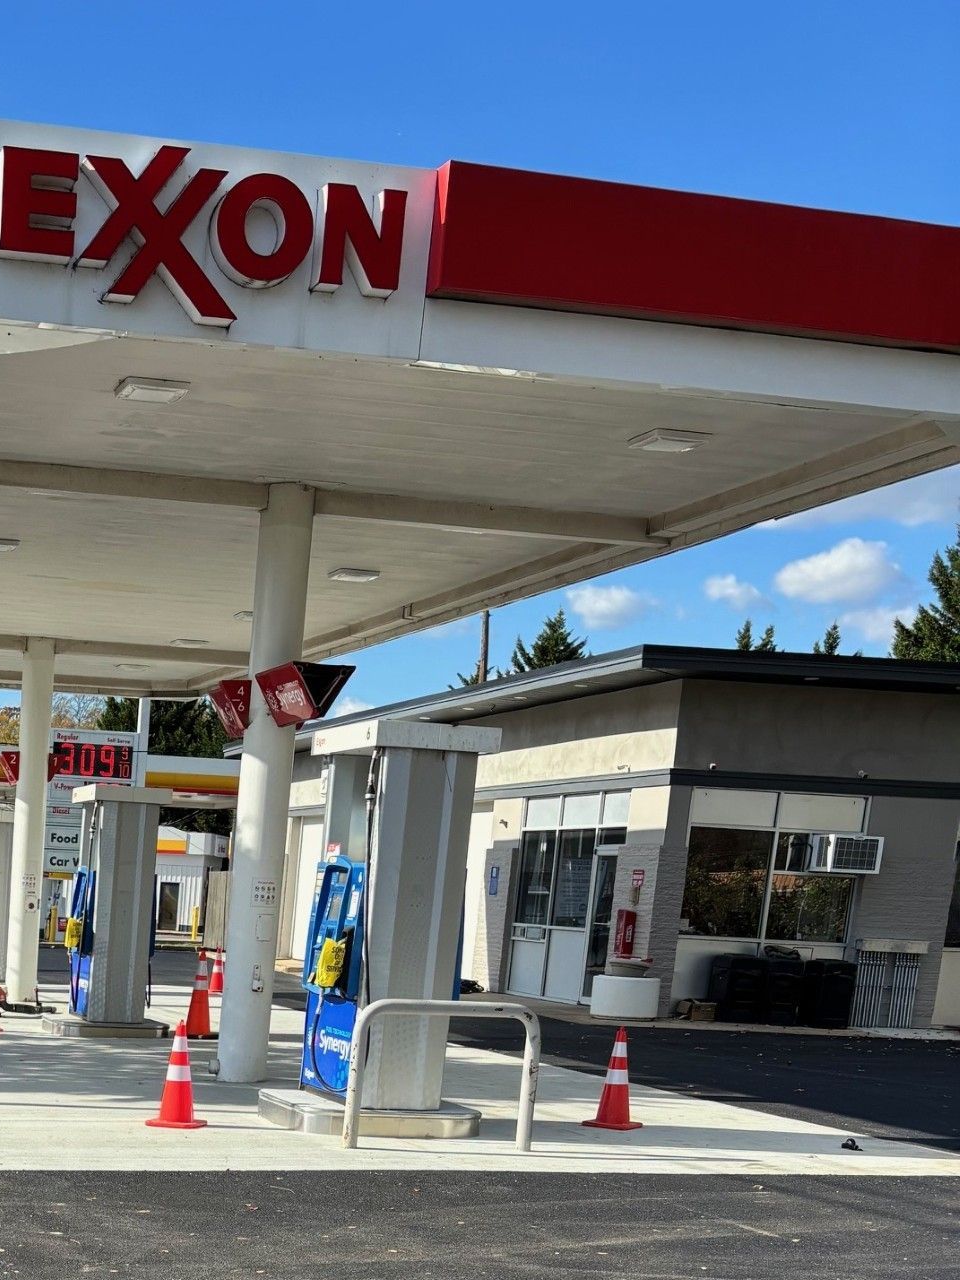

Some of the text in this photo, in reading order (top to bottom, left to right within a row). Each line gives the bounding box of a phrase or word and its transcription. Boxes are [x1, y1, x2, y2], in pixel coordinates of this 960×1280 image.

[237, 686, 245, 696] 4
[238, 701, 245, 712] 6
[56, 732, 79, 742] Regular
[10, 754, 17, 764] 2
[60, 743, 116, 777] 309
[51, 833, 78, 844] Food
[49, 856, 70, 867] Car
[318, 1029, 351, 1062] Synergy
